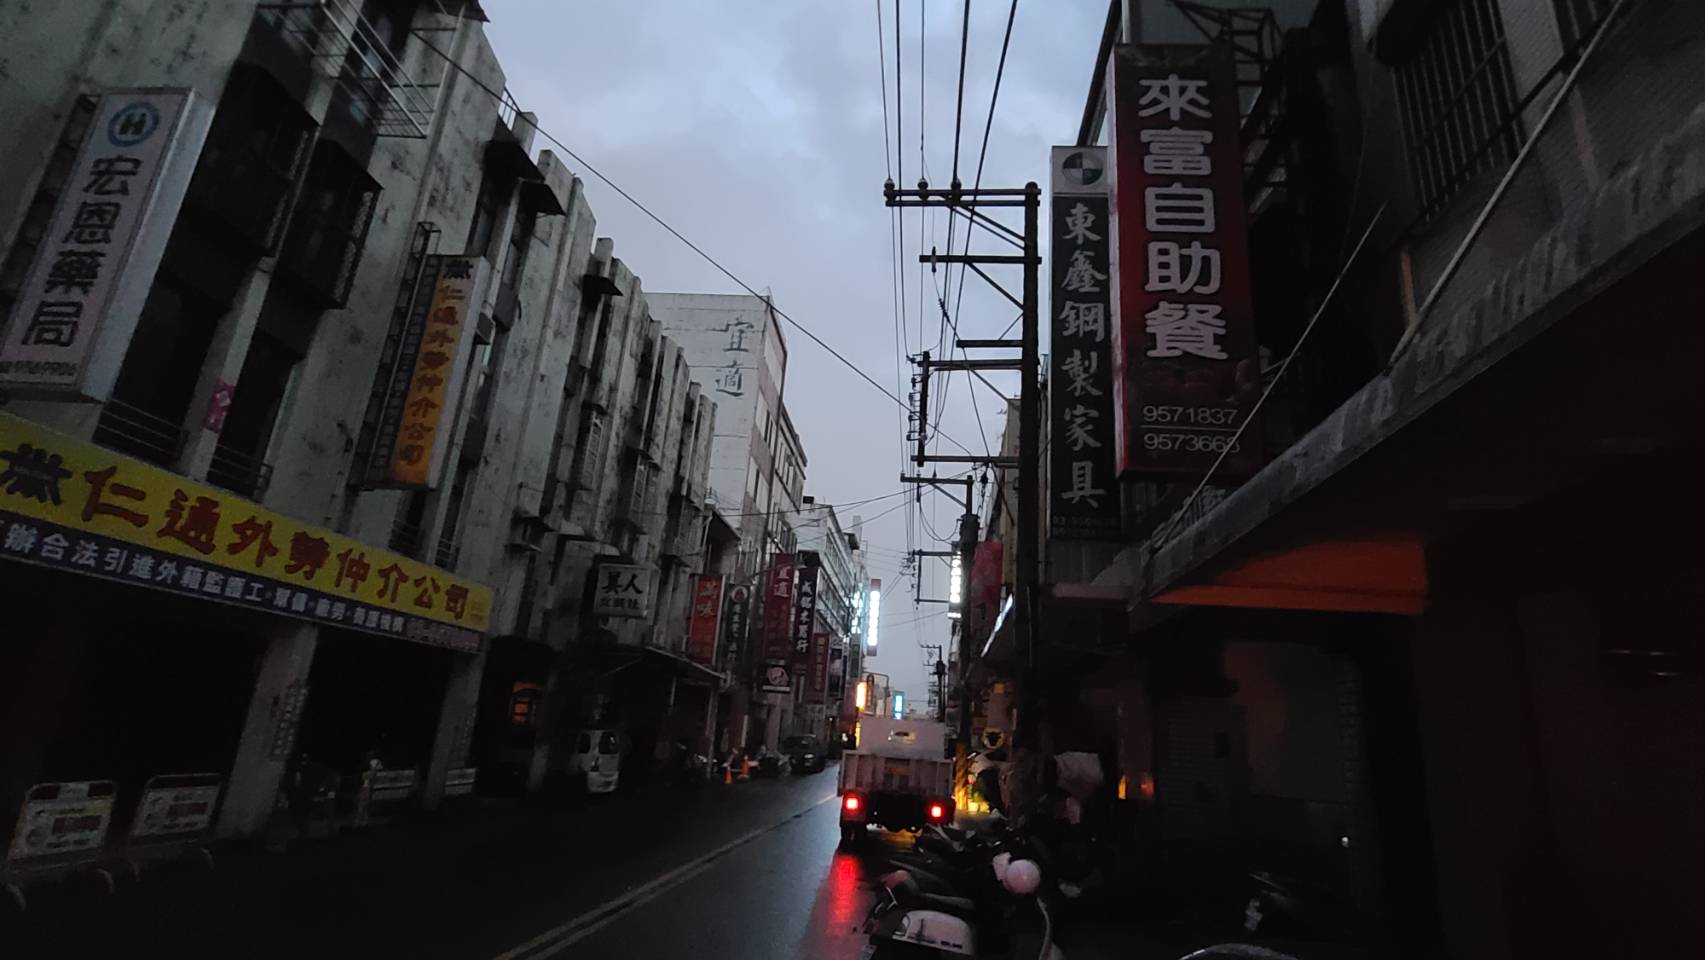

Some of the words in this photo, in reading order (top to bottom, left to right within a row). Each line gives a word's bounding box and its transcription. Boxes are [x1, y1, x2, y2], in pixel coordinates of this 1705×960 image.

[21, 155, 141, 348] 宏恩藥局
[1137, 73, 1229, 361] 來富自助餐
[715, 316, 754, 396] 宜適
[1060, 202, 1108, 510] 東鑫鋼製家具
[1143, 405, 1238, 424] 9571837
[81, 465, 471, 619] 仁通外勞仲介公司
